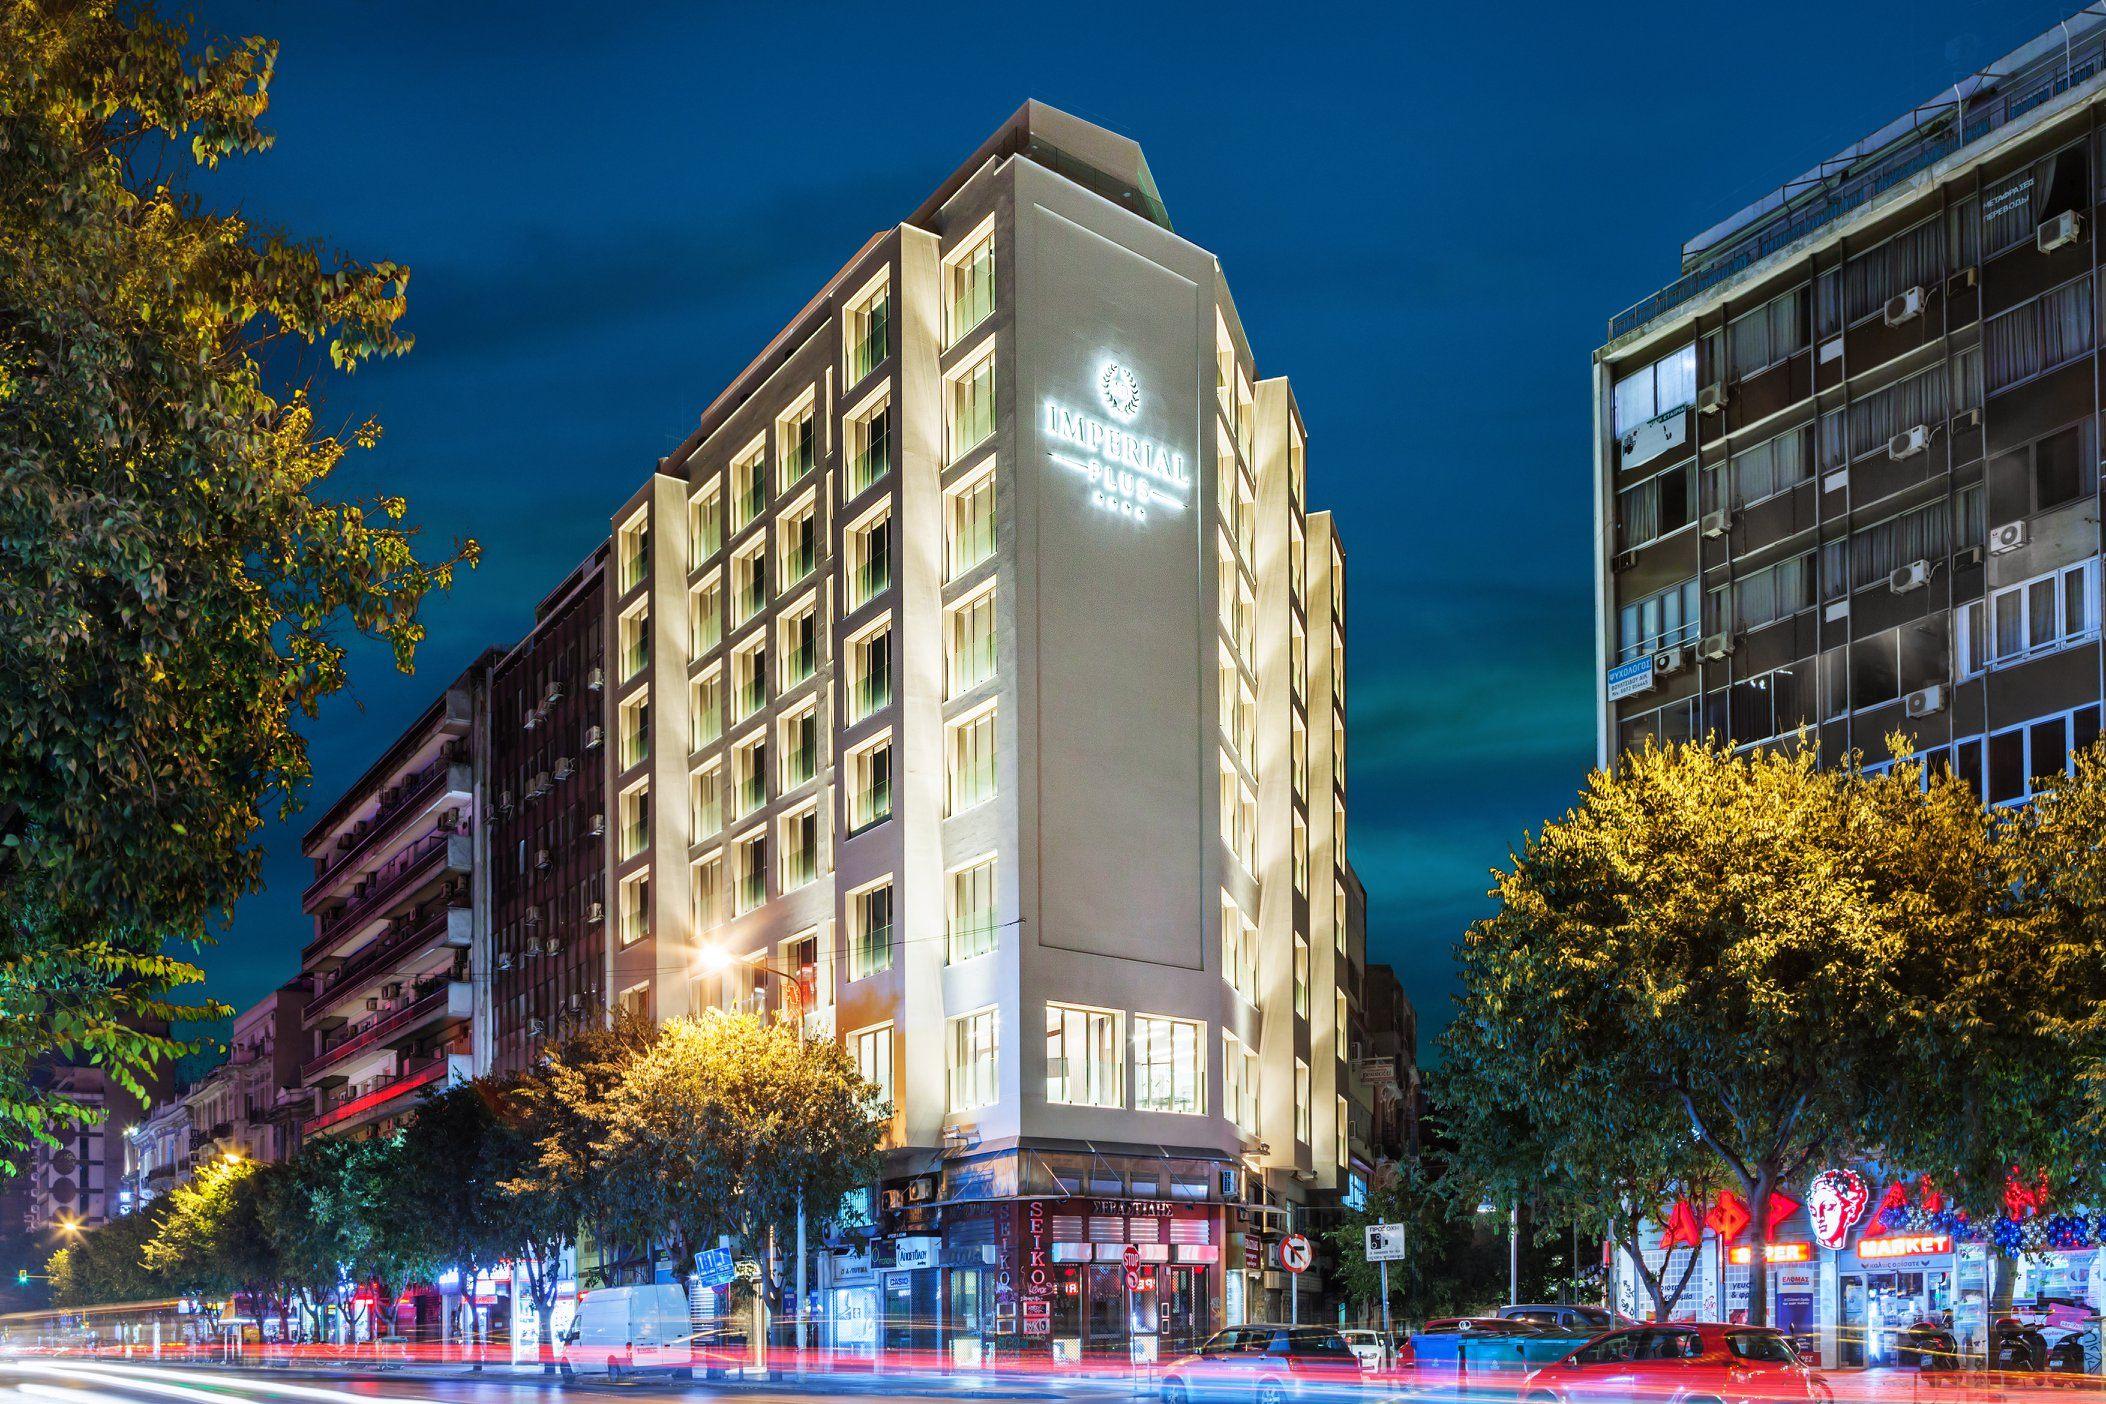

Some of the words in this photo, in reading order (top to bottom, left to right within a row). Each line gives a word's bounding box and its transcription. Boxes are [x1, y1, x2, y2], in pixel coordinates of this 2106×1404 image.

[1050, 405, 1190, 485] IMPERIAL
[1090, 461, 1151, 499] PLUS
[1609, 659, 1651, 681] ΨΥΧΟΛΟΓΟΣ
[1093, 1200, 1174, 1217] ΣΕΒΑΣΤΙΔΗΣ
[1000, 1204, 1011, 1286] SEIKO
[1030, 1201, 1046, 1285] SEIKO
[1860, 1236, 1948, 1256] MARKET
[1124, 1252, 1139, 1267] STOP
